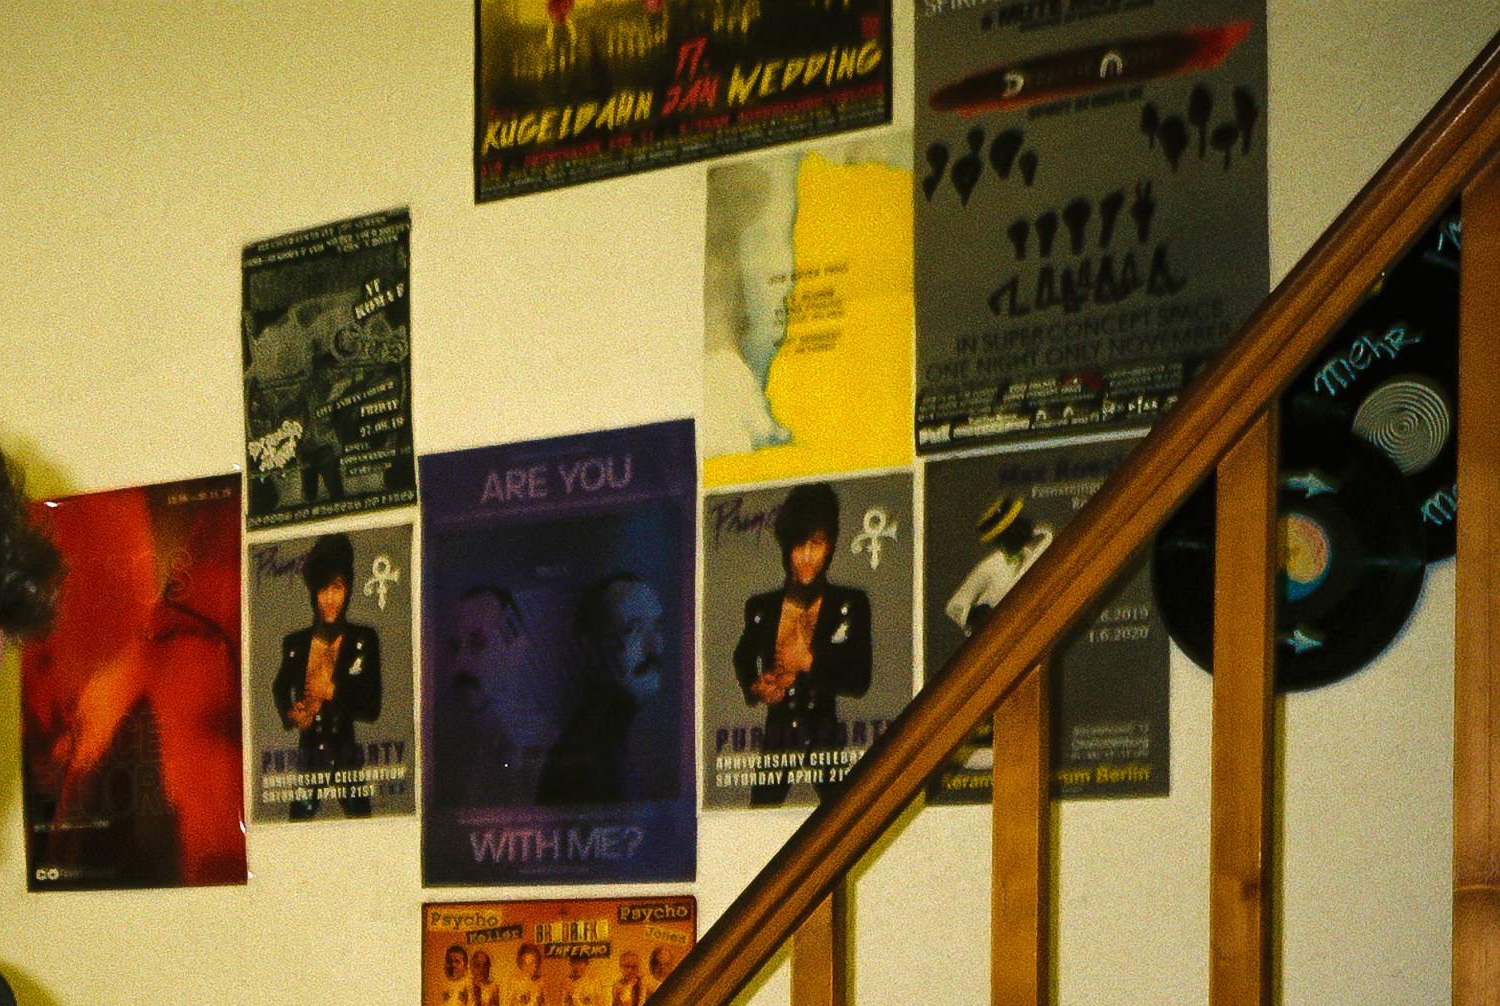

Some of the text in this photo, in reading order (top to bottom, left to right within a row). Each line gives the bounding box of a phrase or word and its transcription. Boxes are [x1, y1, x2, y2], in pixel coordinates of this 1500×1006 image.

[479, 453, 634, 504] ARE YOU
[715, 753, 806, 771] ANNIVERSARY
[715, 770, 784, 788] SATURDAY
[787, 768, 826, 785] APRIL
[469, 824, 645, 864] WITH ME?
[430, 911, 500, 933] Psycho
[619, 904, 689, 923] Psycho
